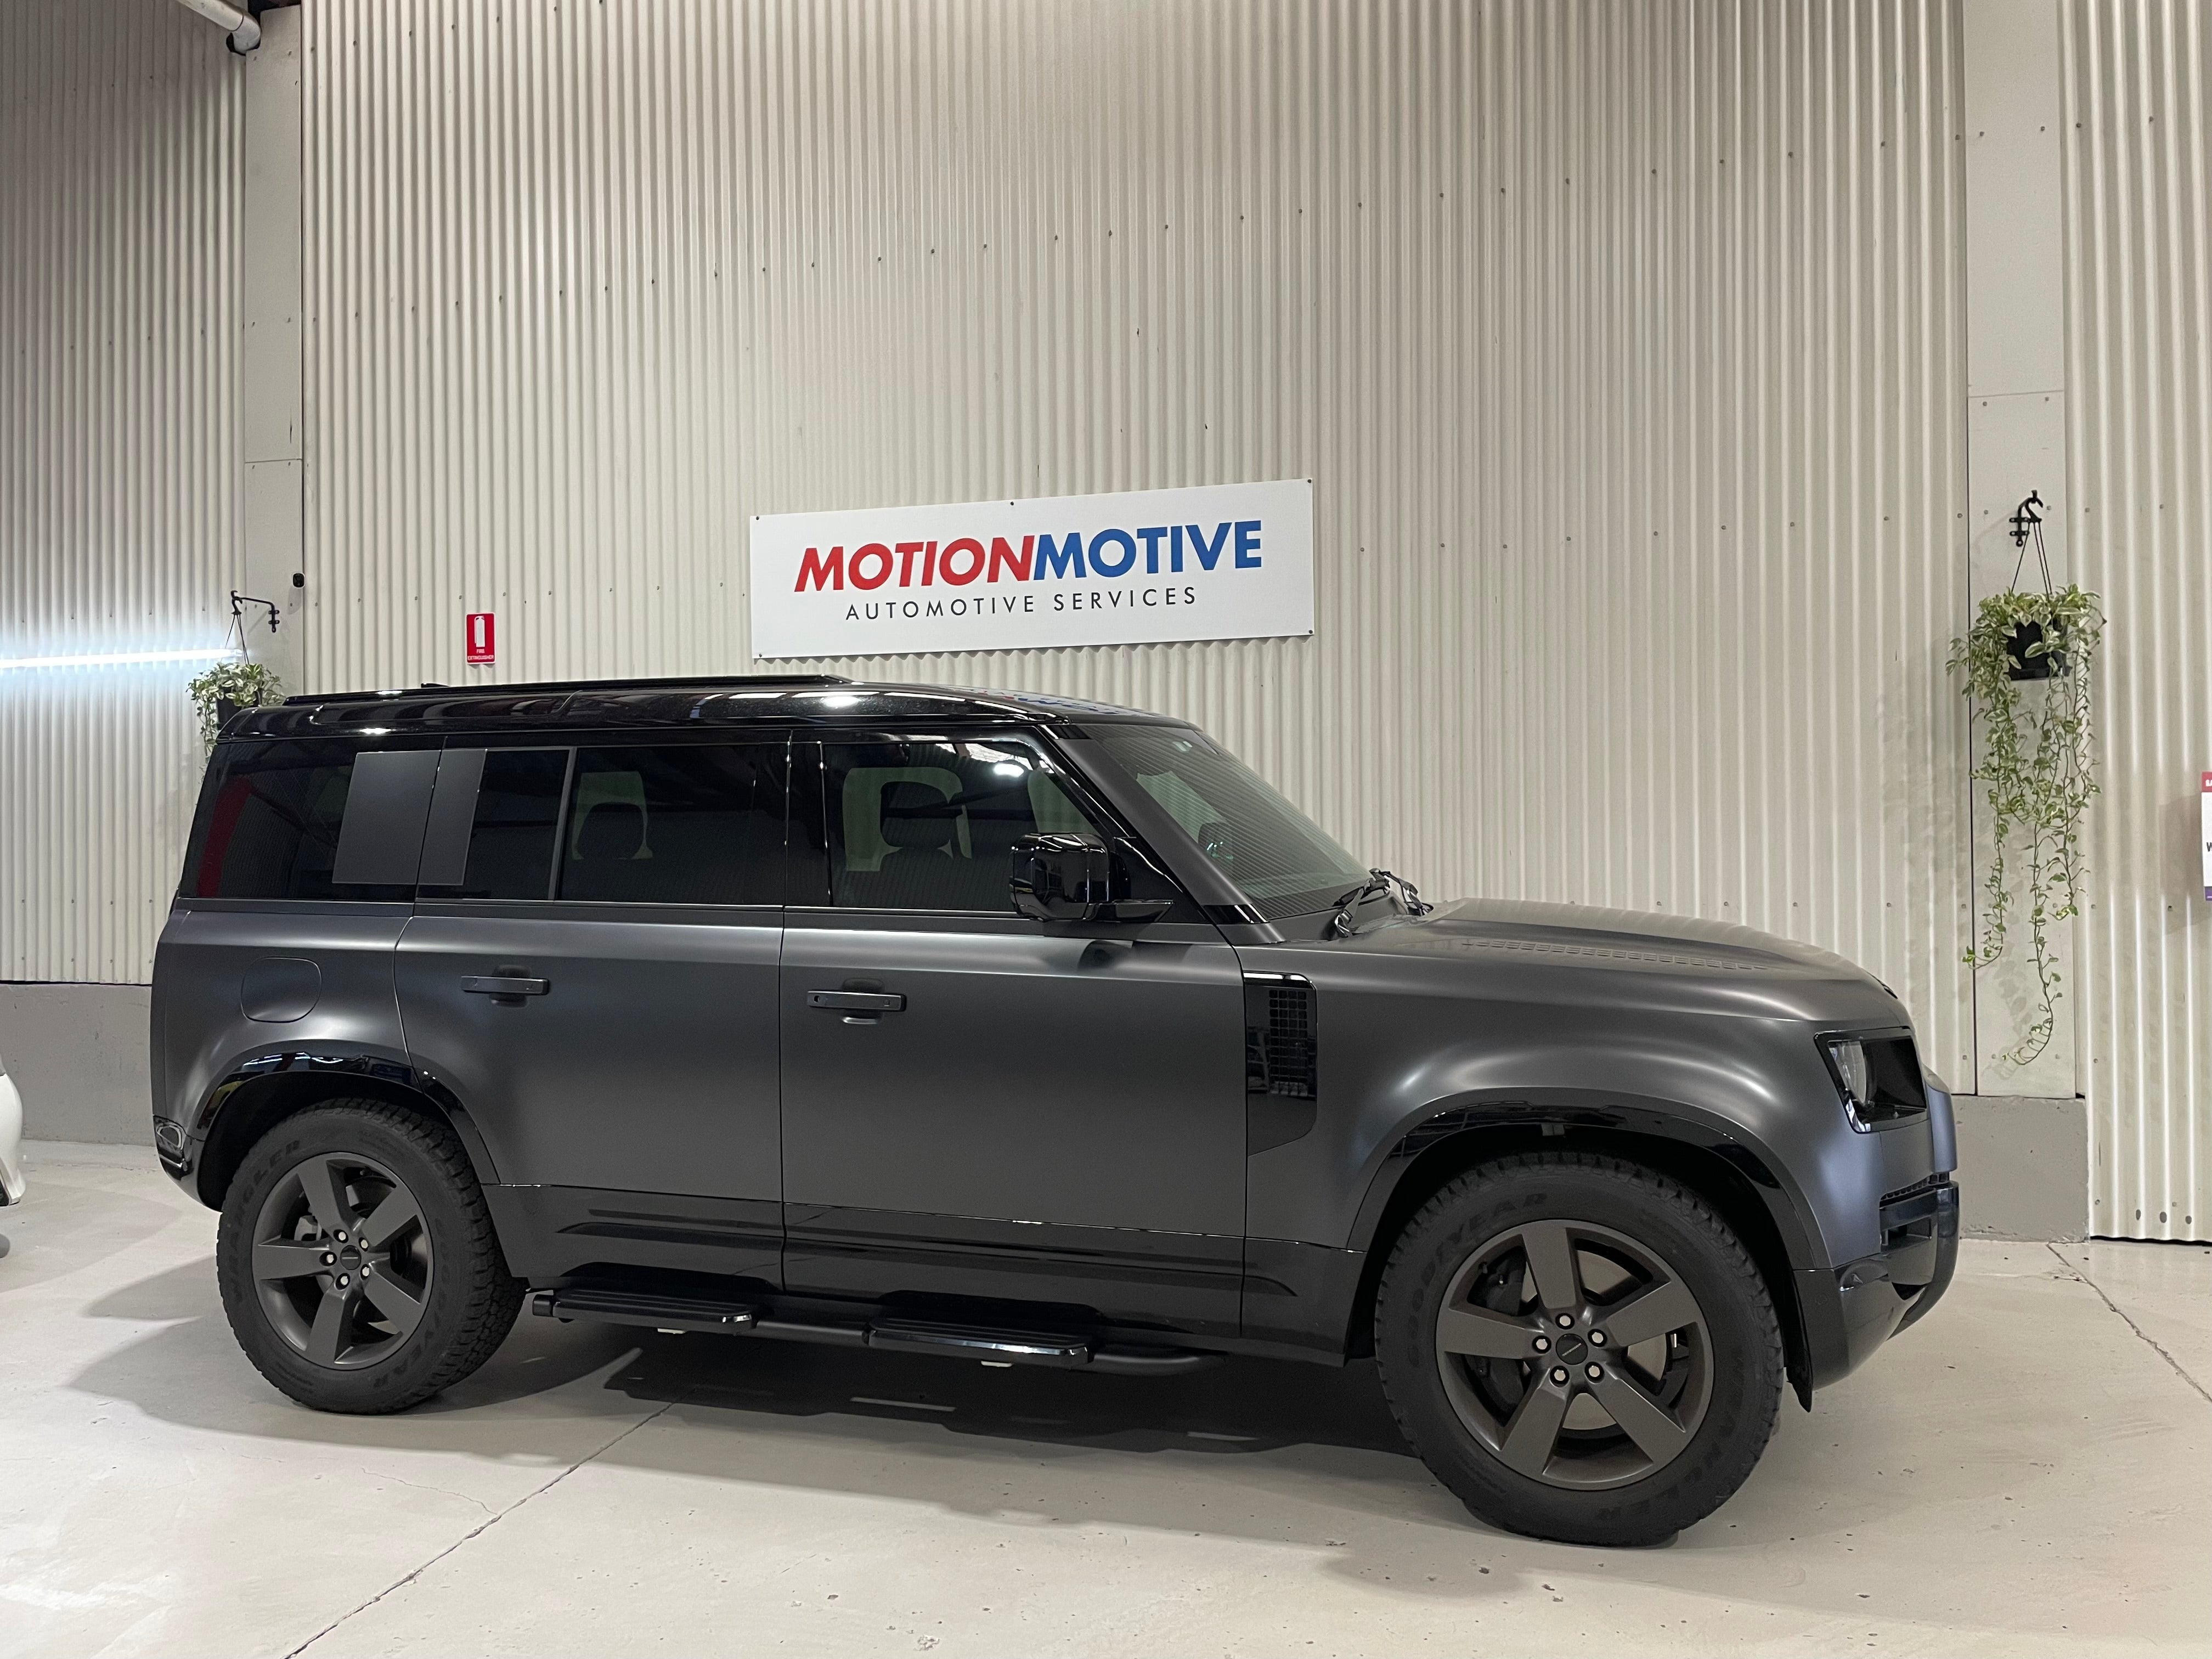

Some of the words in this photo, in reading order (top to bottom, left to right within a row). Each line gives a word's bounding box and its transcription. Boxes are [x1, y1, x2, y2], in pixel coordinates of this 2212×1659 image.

[794, 521, 1262, 592] MOTIONMOTIVE
[845, 595, 1034, 621] AUTOMOTIVE
[1053, 586, 1195, 611] SERVICES
